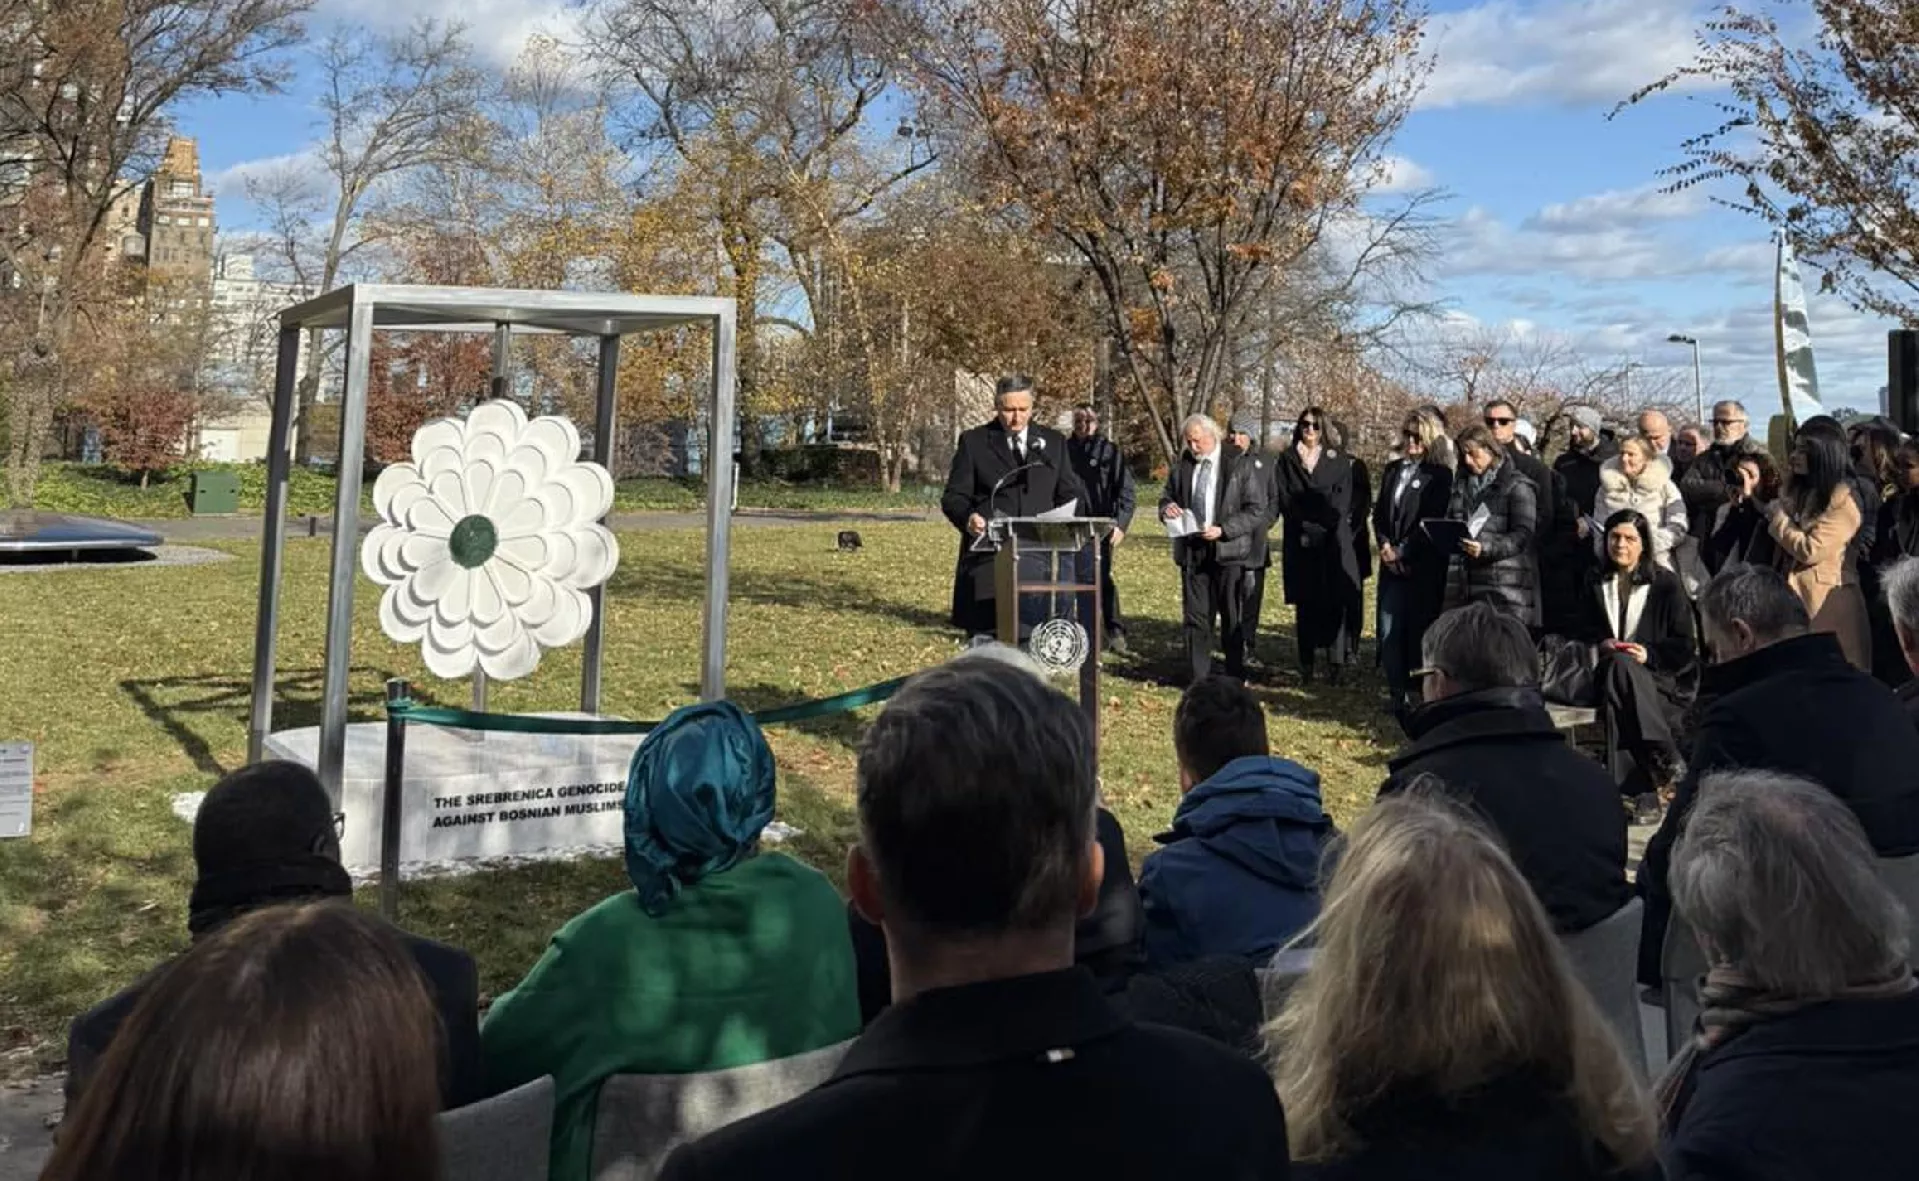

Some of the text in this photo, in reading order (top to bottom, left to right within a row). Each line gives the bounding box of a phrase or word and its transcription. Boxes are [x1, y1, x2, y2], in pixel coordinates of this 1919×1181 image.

[434, 781, 626, 808] THE SREBRENICA GENOCIDE
[433, 812, 495, 828] AGAINST
[499, 806, 560, 821] BOSNIAN
